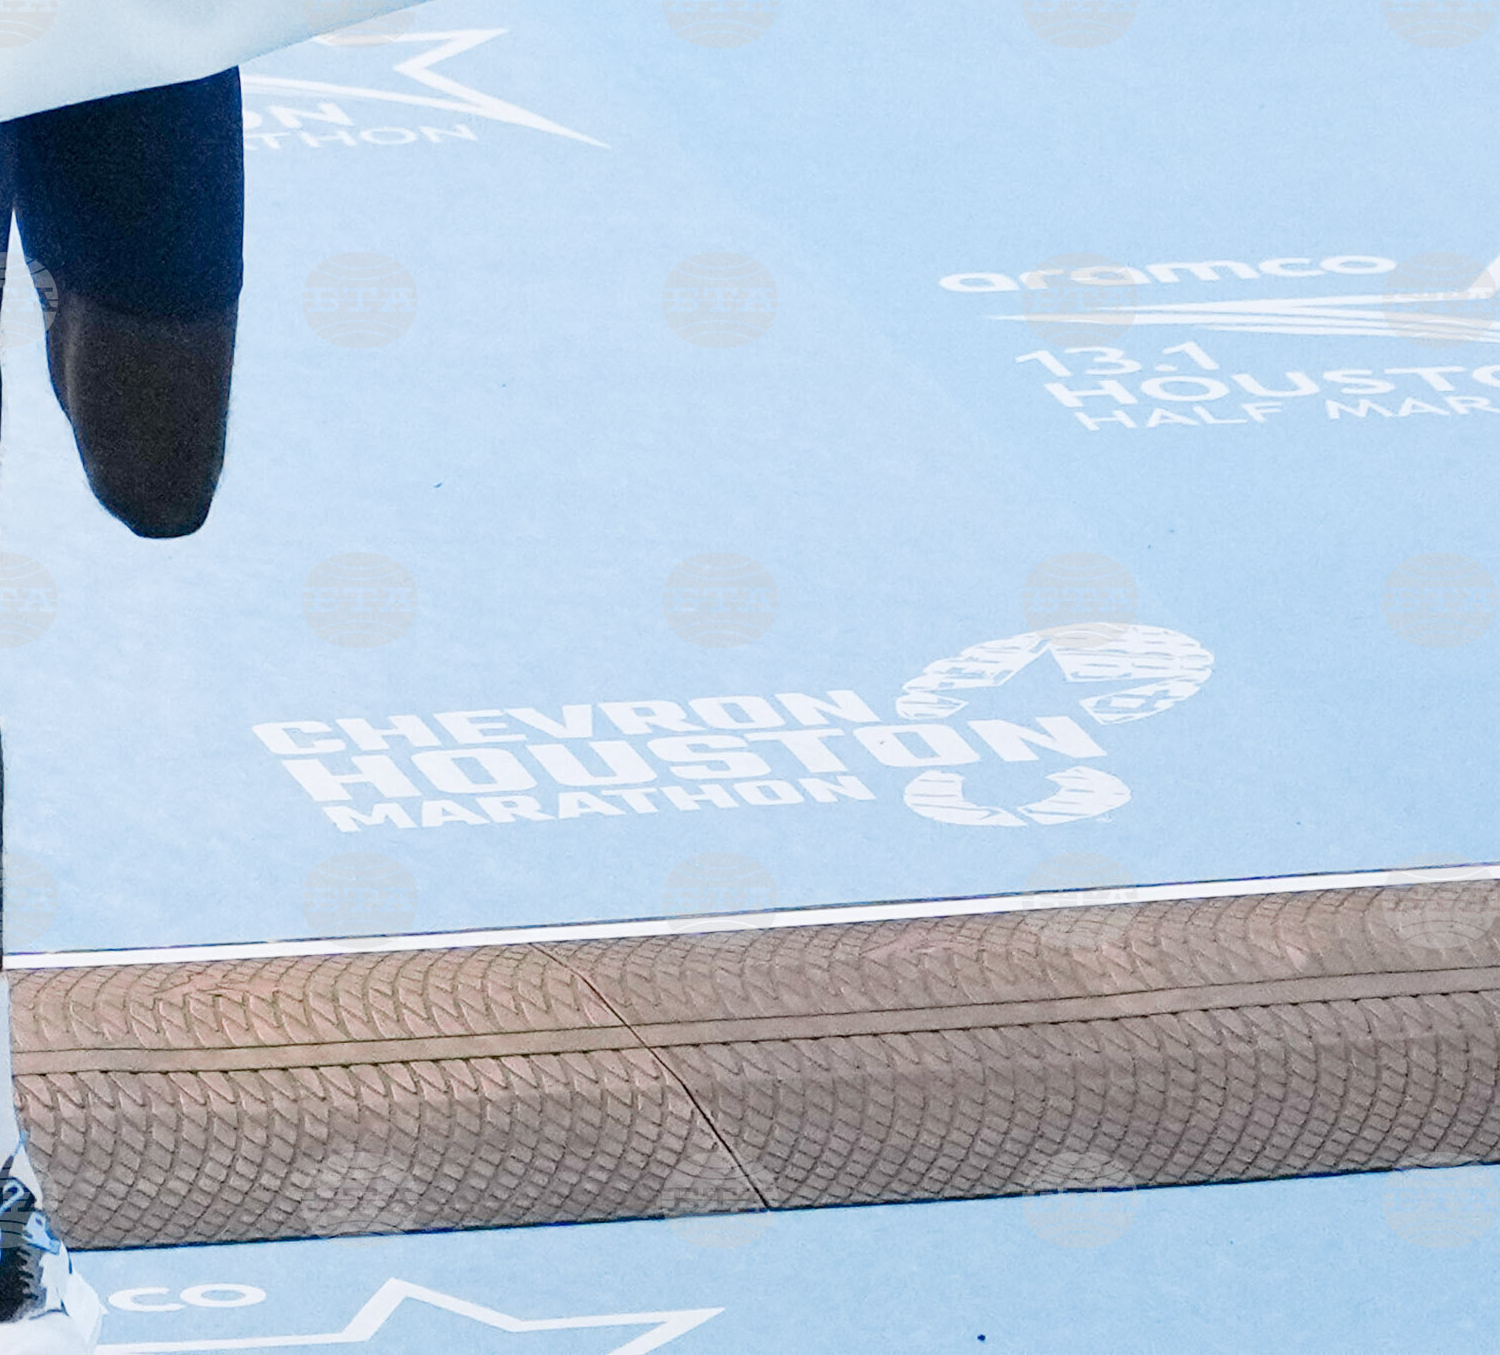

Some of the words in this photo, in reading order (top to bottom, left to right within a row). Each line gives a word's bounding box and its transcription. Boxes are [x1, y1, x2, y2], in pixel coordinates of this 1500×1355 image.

[938, 254, 1396, 294] aramco
[1015, 341, 1220, 378] 13.1
[1074, 401, 1288, 431] HALF
[252, 690, 882, 756] CHEVRON
[280, 716, 1108, 803] HOUSTON
[322, 774, 877, 834] MARATHON
